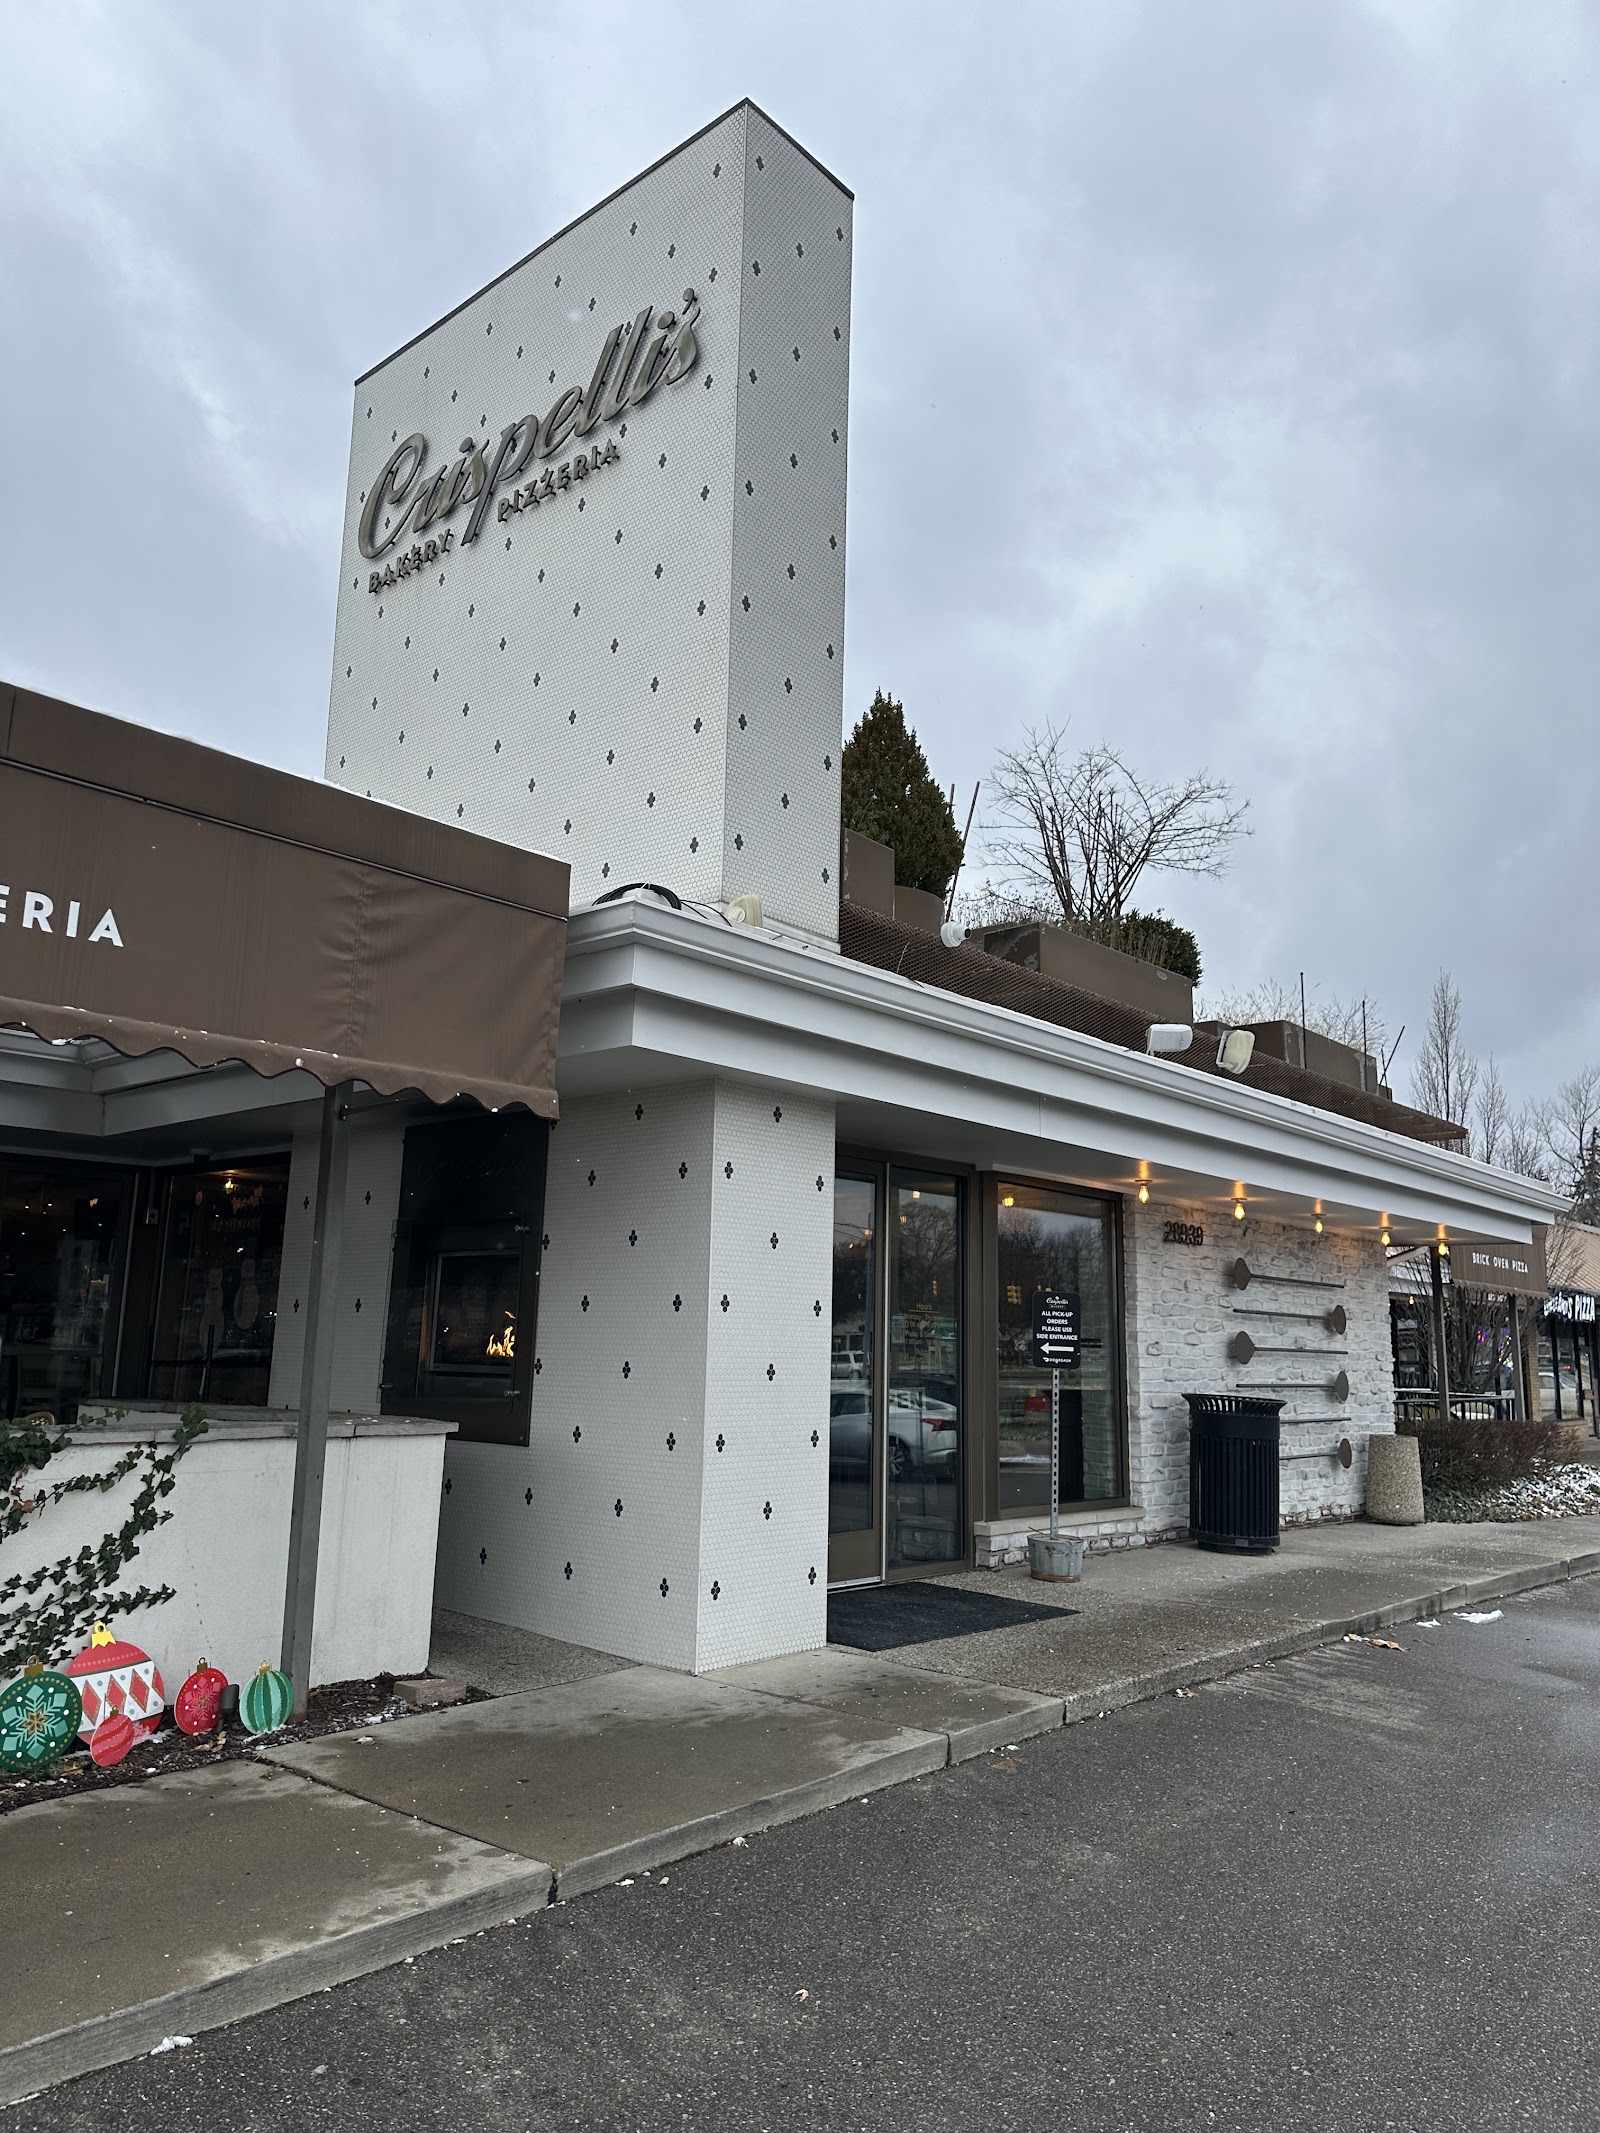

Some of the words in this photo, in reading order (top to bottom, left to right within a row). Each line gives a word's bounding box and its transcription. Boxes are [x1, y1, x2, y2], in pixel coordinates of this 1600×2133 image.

[358, 287, 701, 559] Crispelli's
[368, 528, 454, 594] BAKERY
[497, 438, 621, 522] PIZZERIA
[1472, 1252, 1490, 1266] BRICK
[1493, 1256, 1509, 1269] OVEN
[1512, 1260, 1529, 1273] PIZZA
[916, 1302, 933, 1311] Hours
[1574, 1294, 1596, 1322] PIZZA
